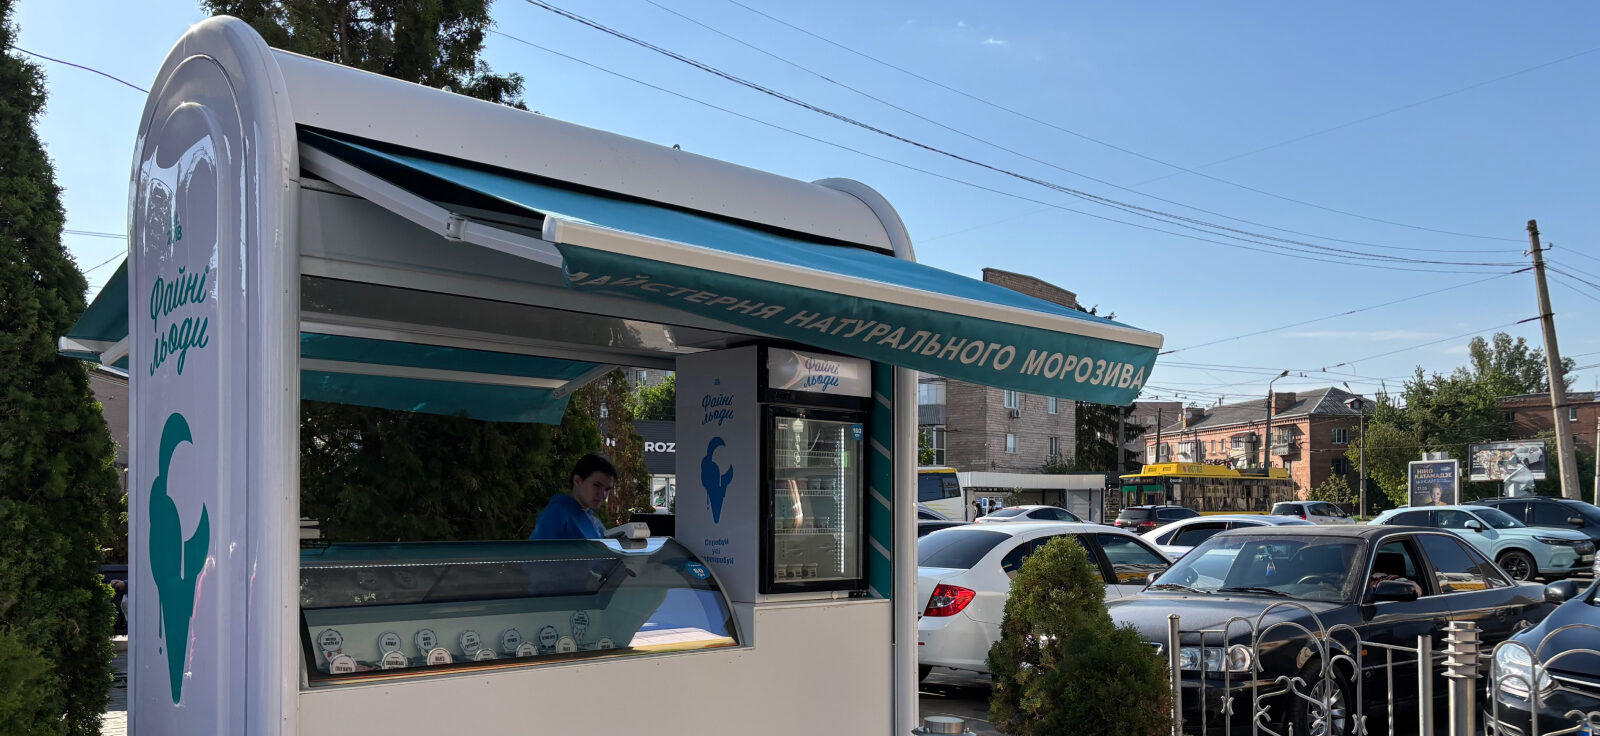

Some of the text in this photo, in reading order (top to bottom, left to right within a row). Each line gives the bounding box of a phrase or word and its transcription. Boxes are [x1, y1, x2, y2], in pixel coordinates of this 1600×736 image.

[167, 225, 182, 247] 218
[150, 264, 210, 333] Файні
[149, 316, 209, 377] льоди
[784, 309, 1017, 371] НАТУРАЛЬНОГО
[1020, 350, 1145, 391] МОРОЗИВА
[805, 357, 840, 375] Файні
[803, 374, 839, 392] льоди
[702, 393, 734, 412] Файні
[702, 408, 734, 426] льоди
[644, 441, 676, 453] ROZ
